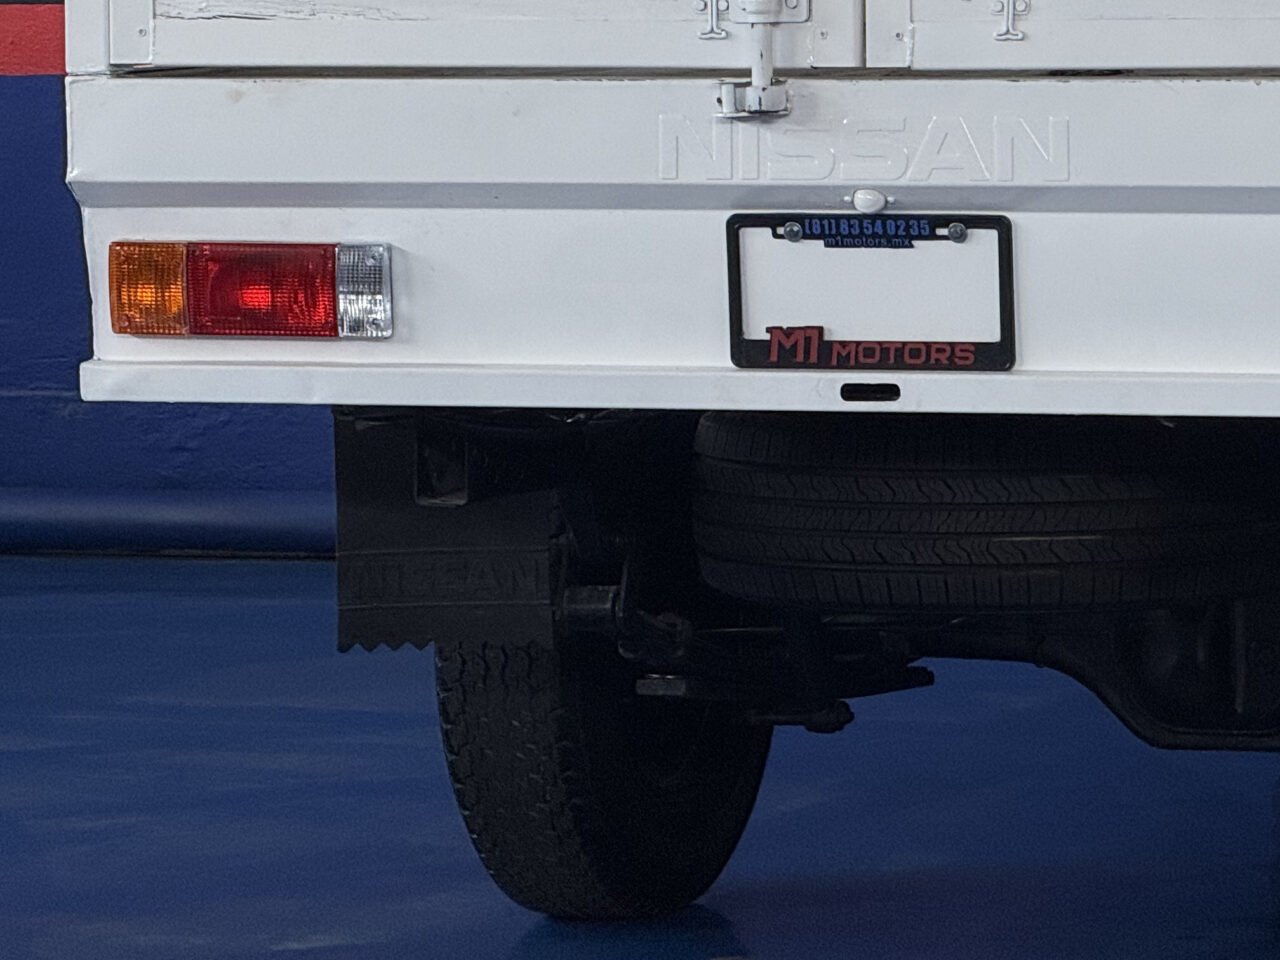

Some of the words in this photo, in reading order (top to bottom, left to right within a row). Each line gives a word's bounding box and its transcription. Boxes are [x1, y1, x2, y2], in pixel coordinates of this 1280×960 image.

[657, 113, 1072, 182] NISSAN
[823, 237, 911, 248] m1motors.mx
[767, 326, 821, 365] M1
[830, 341, 976, 367] MOTORS
